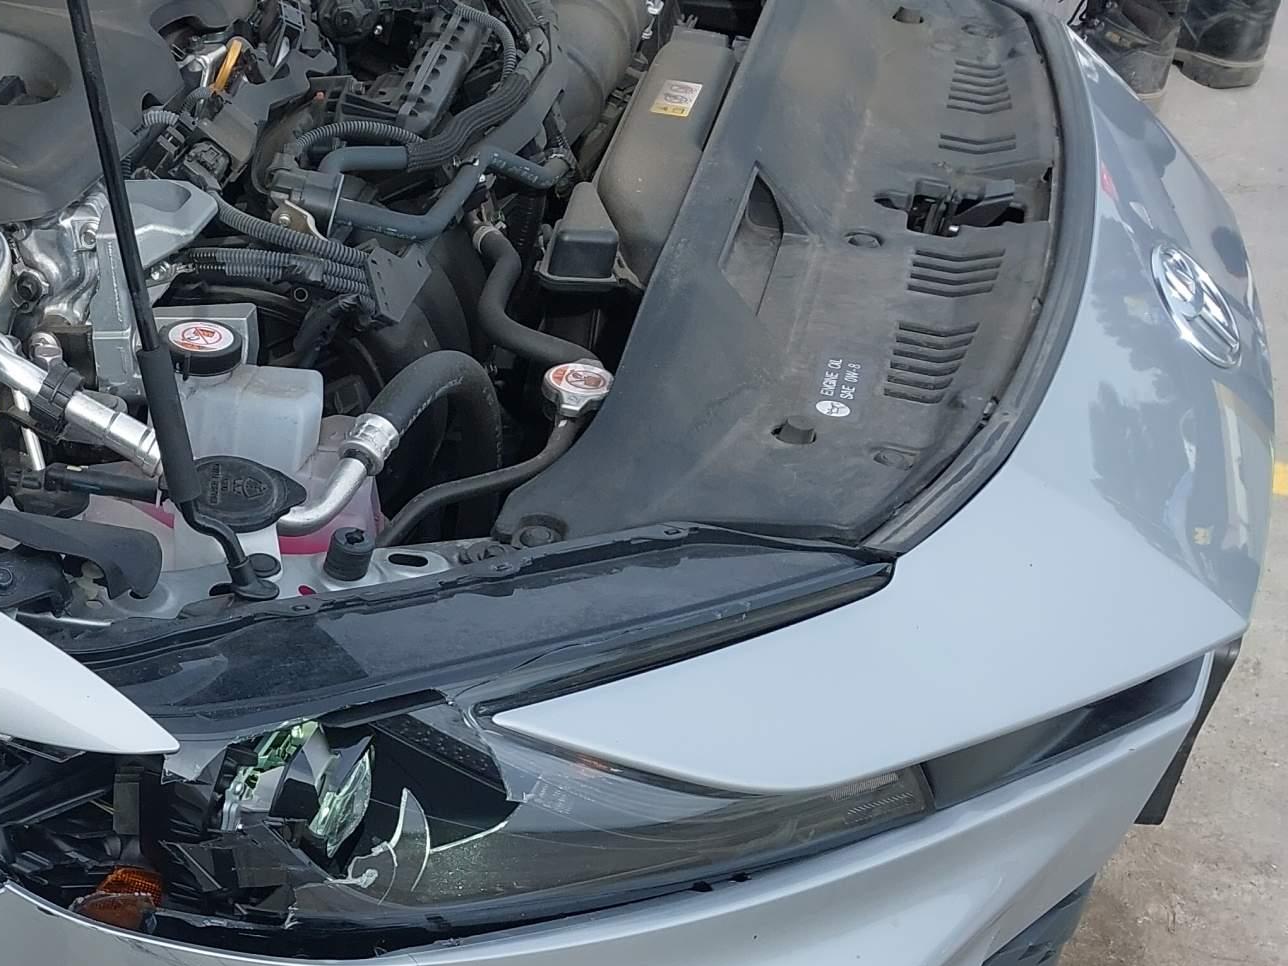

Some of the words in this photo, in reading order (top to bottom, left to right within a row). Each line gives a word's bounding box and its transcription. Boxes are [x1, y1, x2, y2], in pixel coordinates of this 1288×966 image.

[828, 359, 843, 369] OIL
[820, 371, 839, 396] ENGINE
[840, 385, 856, 400] SAE
